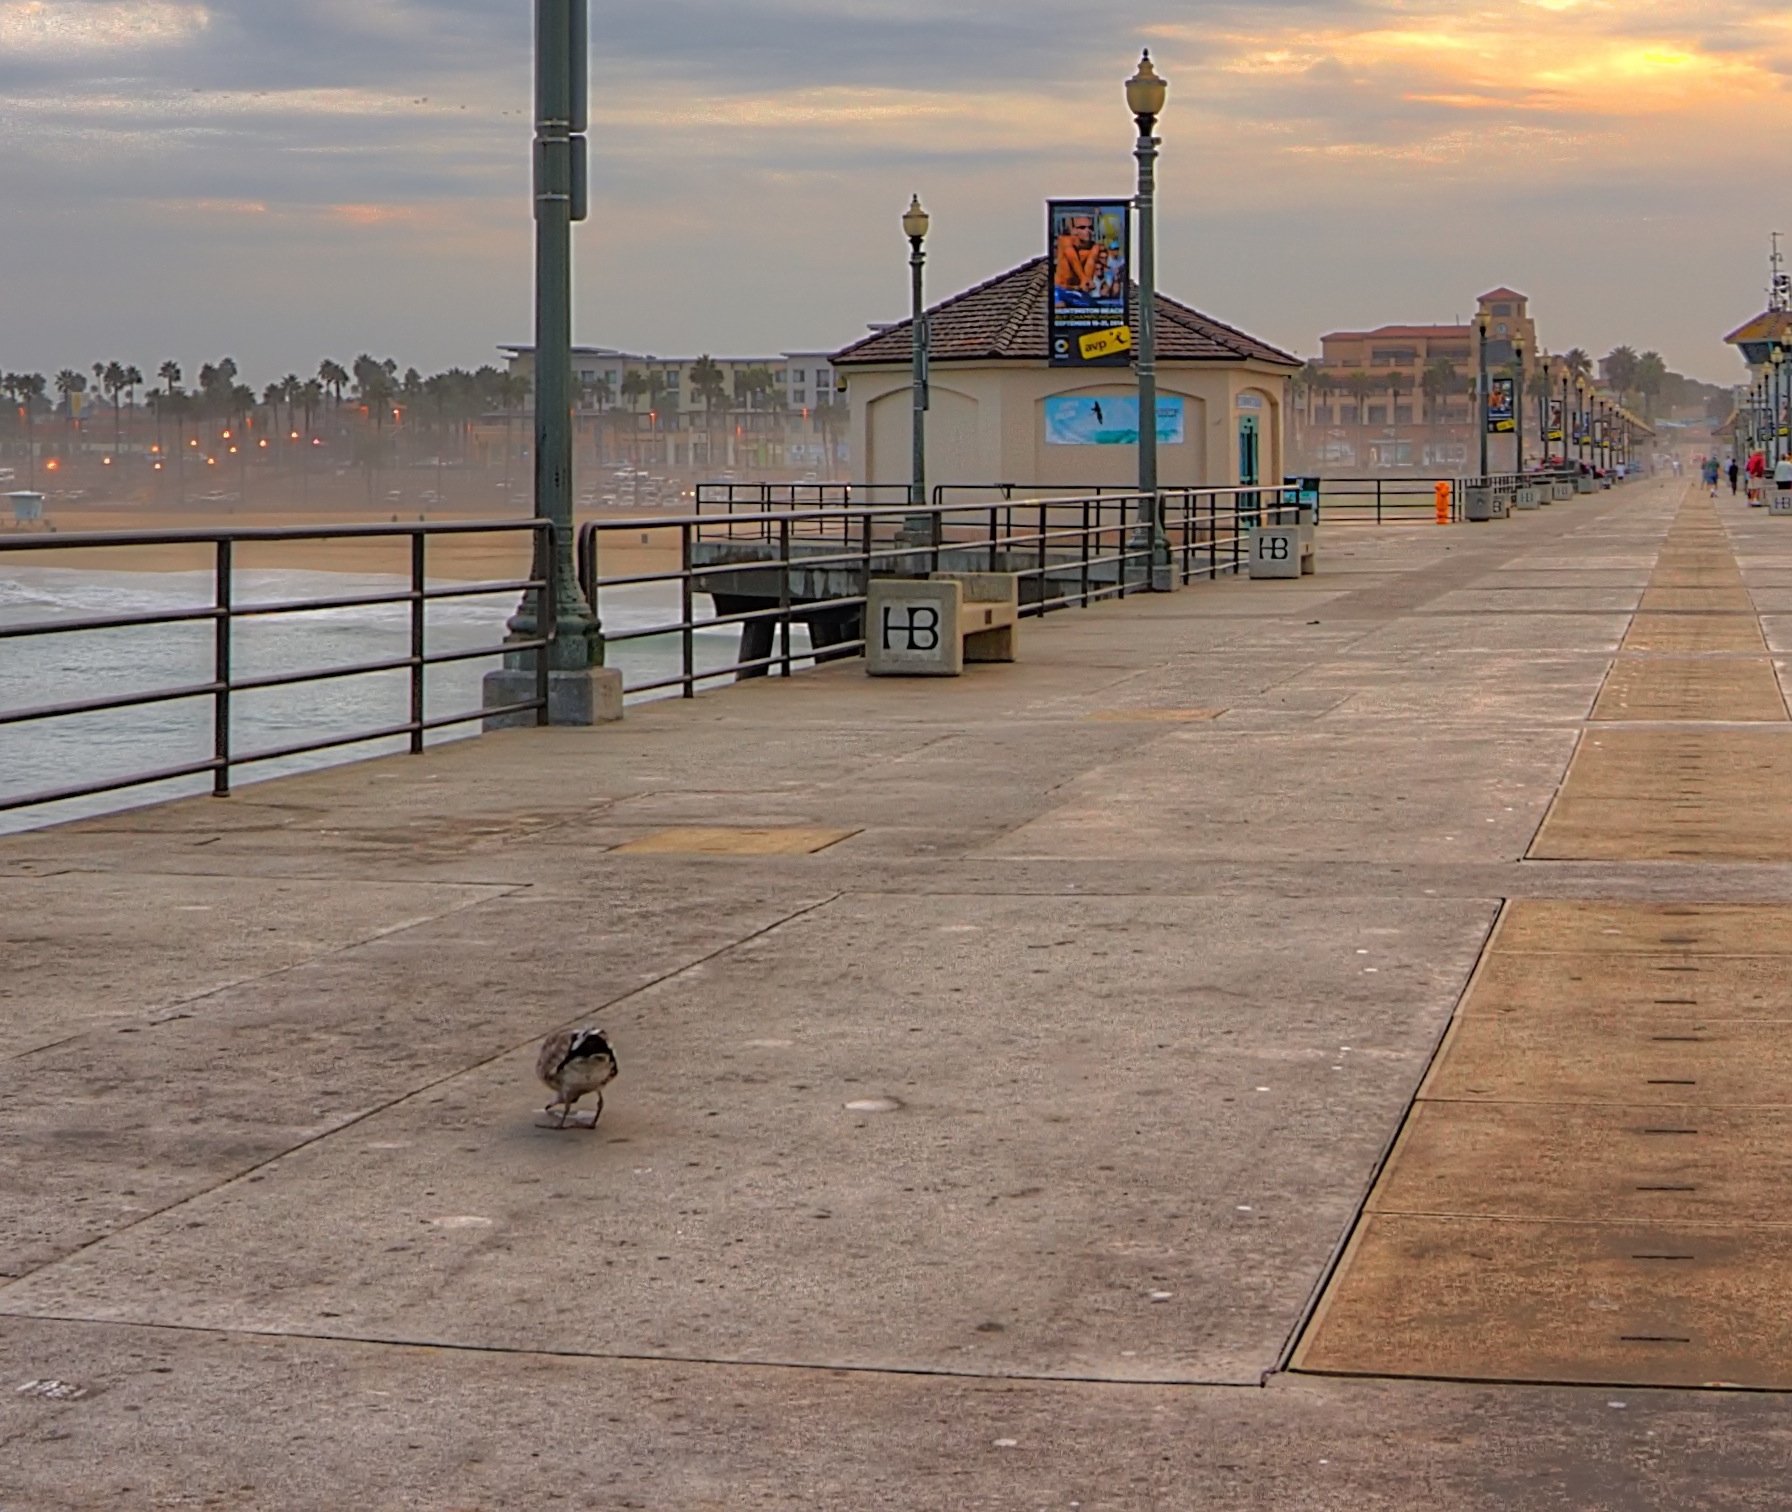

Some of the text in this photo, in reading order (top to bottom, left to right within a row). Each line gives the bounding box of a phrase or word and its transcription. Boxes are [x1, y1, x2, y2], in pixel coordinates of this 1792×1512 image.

[1085, 340, 1107, 352] avp
[1775, 497, 1791, 509] HB
[1259, 537, 1288, 559] HB
[883, 607, 939, 650] HB
